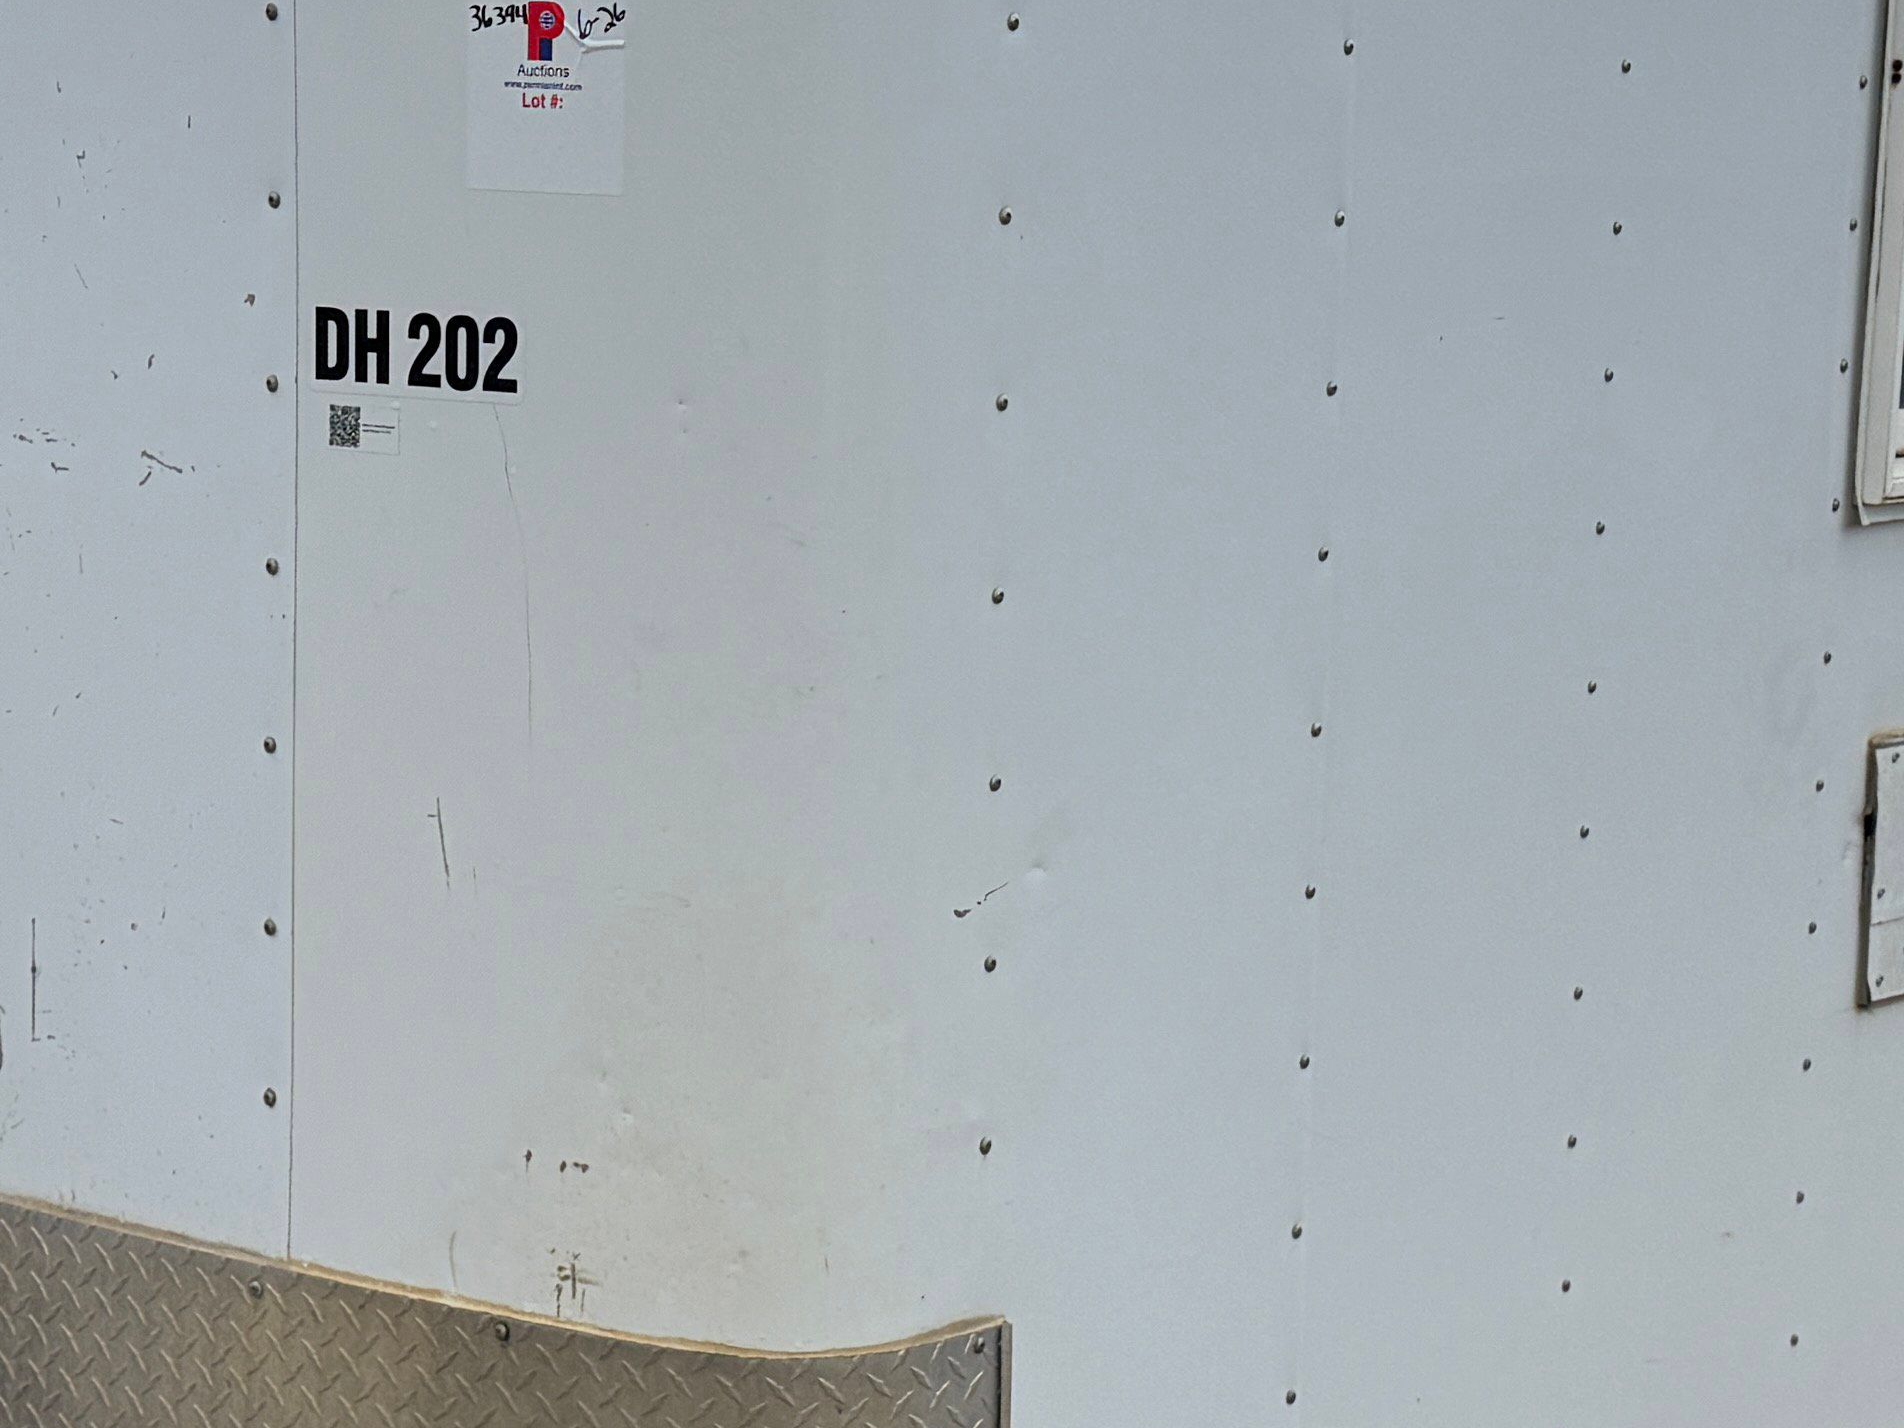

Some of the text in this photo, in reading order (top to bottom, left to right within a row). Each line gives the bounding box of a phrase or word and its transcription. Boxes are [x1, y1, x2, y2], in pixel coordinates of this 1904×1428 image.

[517, 63, 570, 78] Auctions
[522, 92, 546, 109] Lot
[315, 306, 518, 393] DH 202
